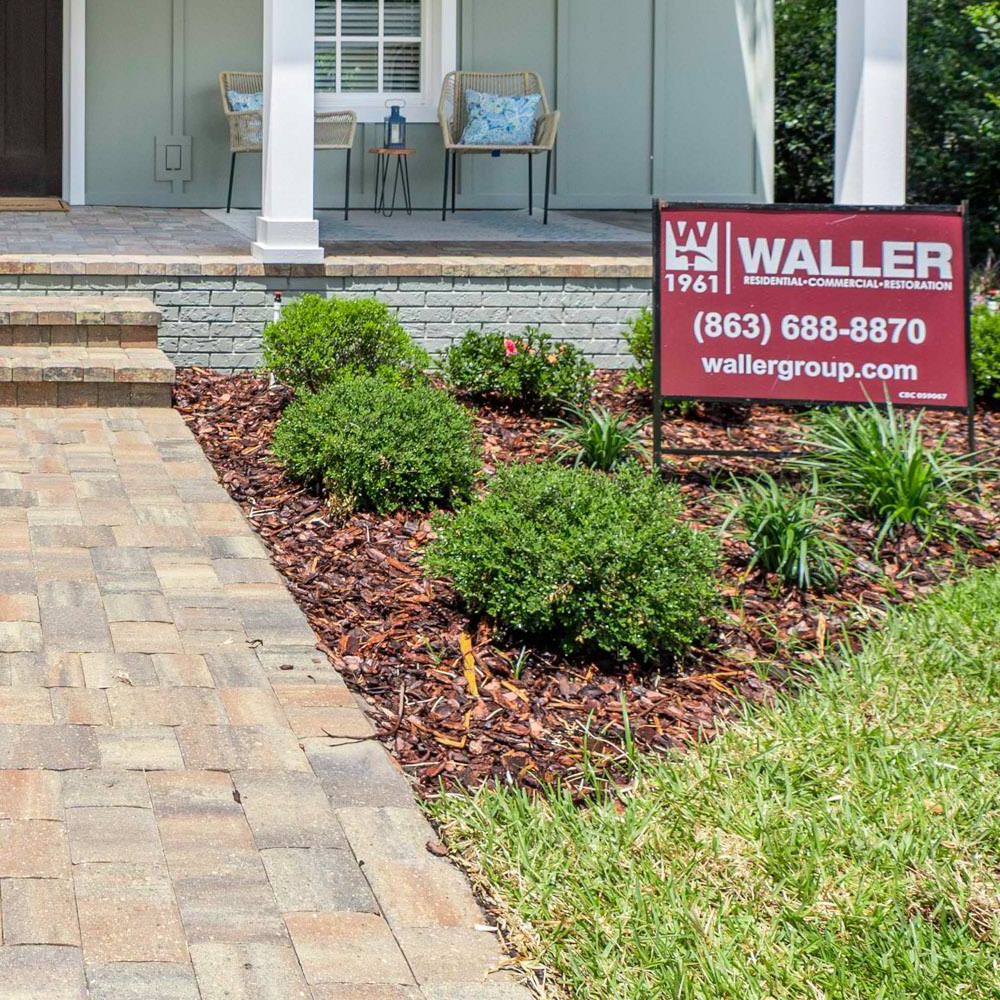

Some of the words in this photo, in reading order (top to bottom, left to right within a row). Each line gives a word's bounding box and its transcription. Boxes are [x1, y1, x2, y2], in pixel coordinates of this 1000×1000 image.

[737, 236, 953, 279] WALLER
[664, 273, 718, 294] 1961
[693, 311, 772, 346] (863)
[781, 314, 927, 345] 688-8870
[701, 353, 918, 383] wallergroup.com
